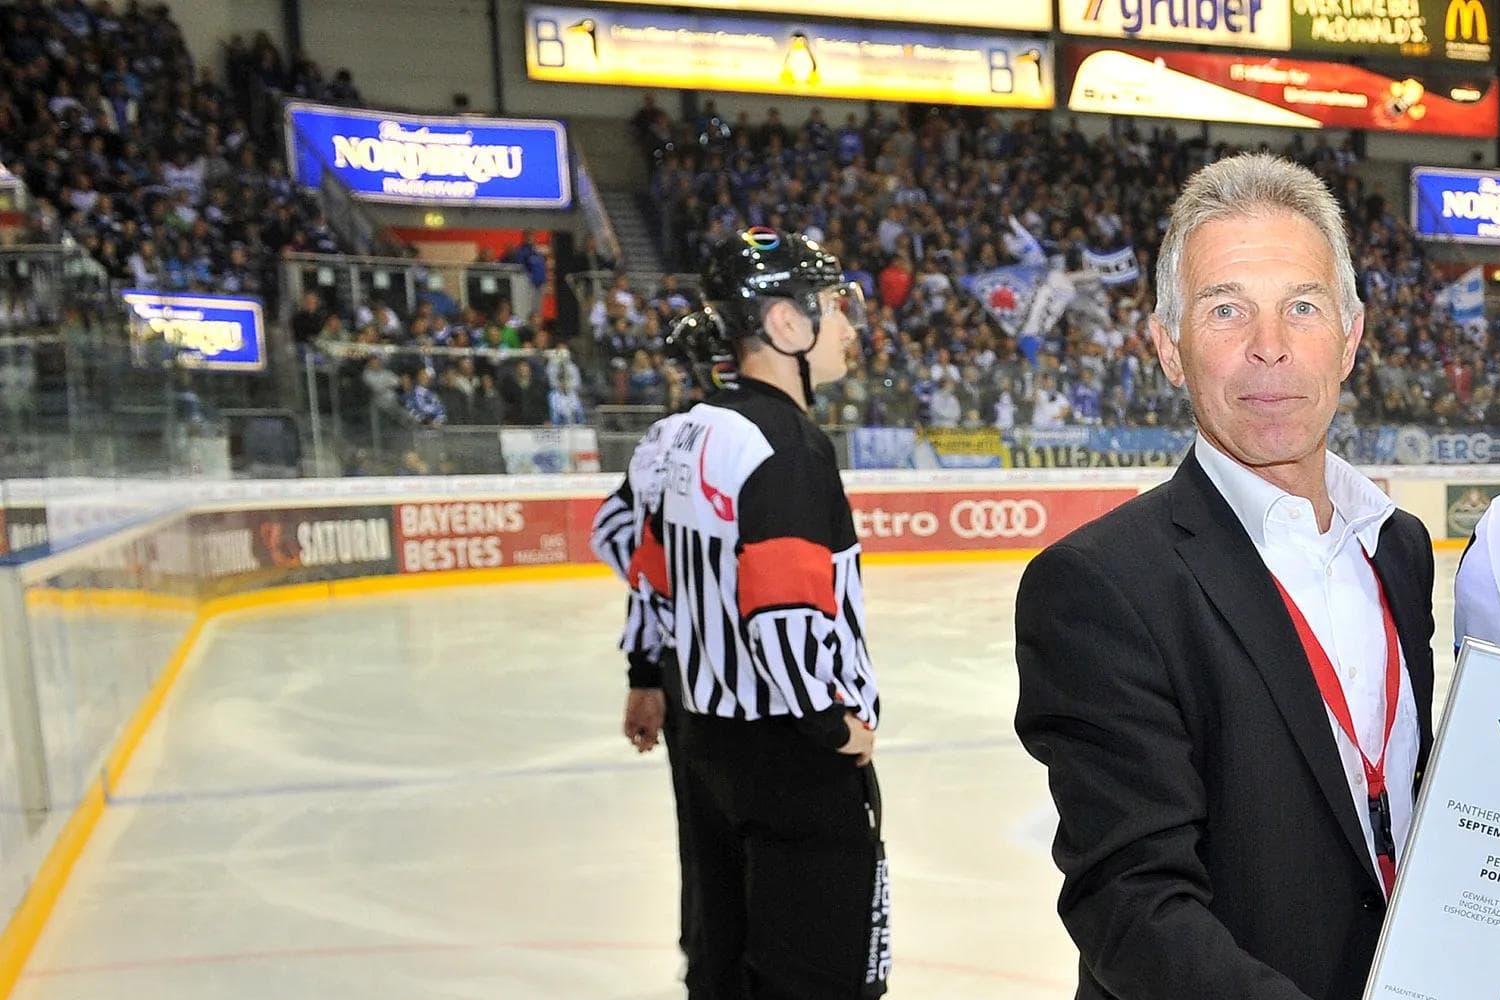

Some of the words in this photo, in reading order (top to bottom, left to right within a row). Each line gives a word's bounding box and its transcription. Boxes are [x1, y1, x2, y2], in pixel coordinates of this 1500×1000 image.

[1120, 0, 1260, 34] gruber
[400, 501, 525, 537] BAYERNS
[855, 508, 939, 538] ttro
[298, 517, 392, 568] SATURN
[403, 536, 504, 572] BESTES
[1447, 799, 1500, 823] PANTHER
